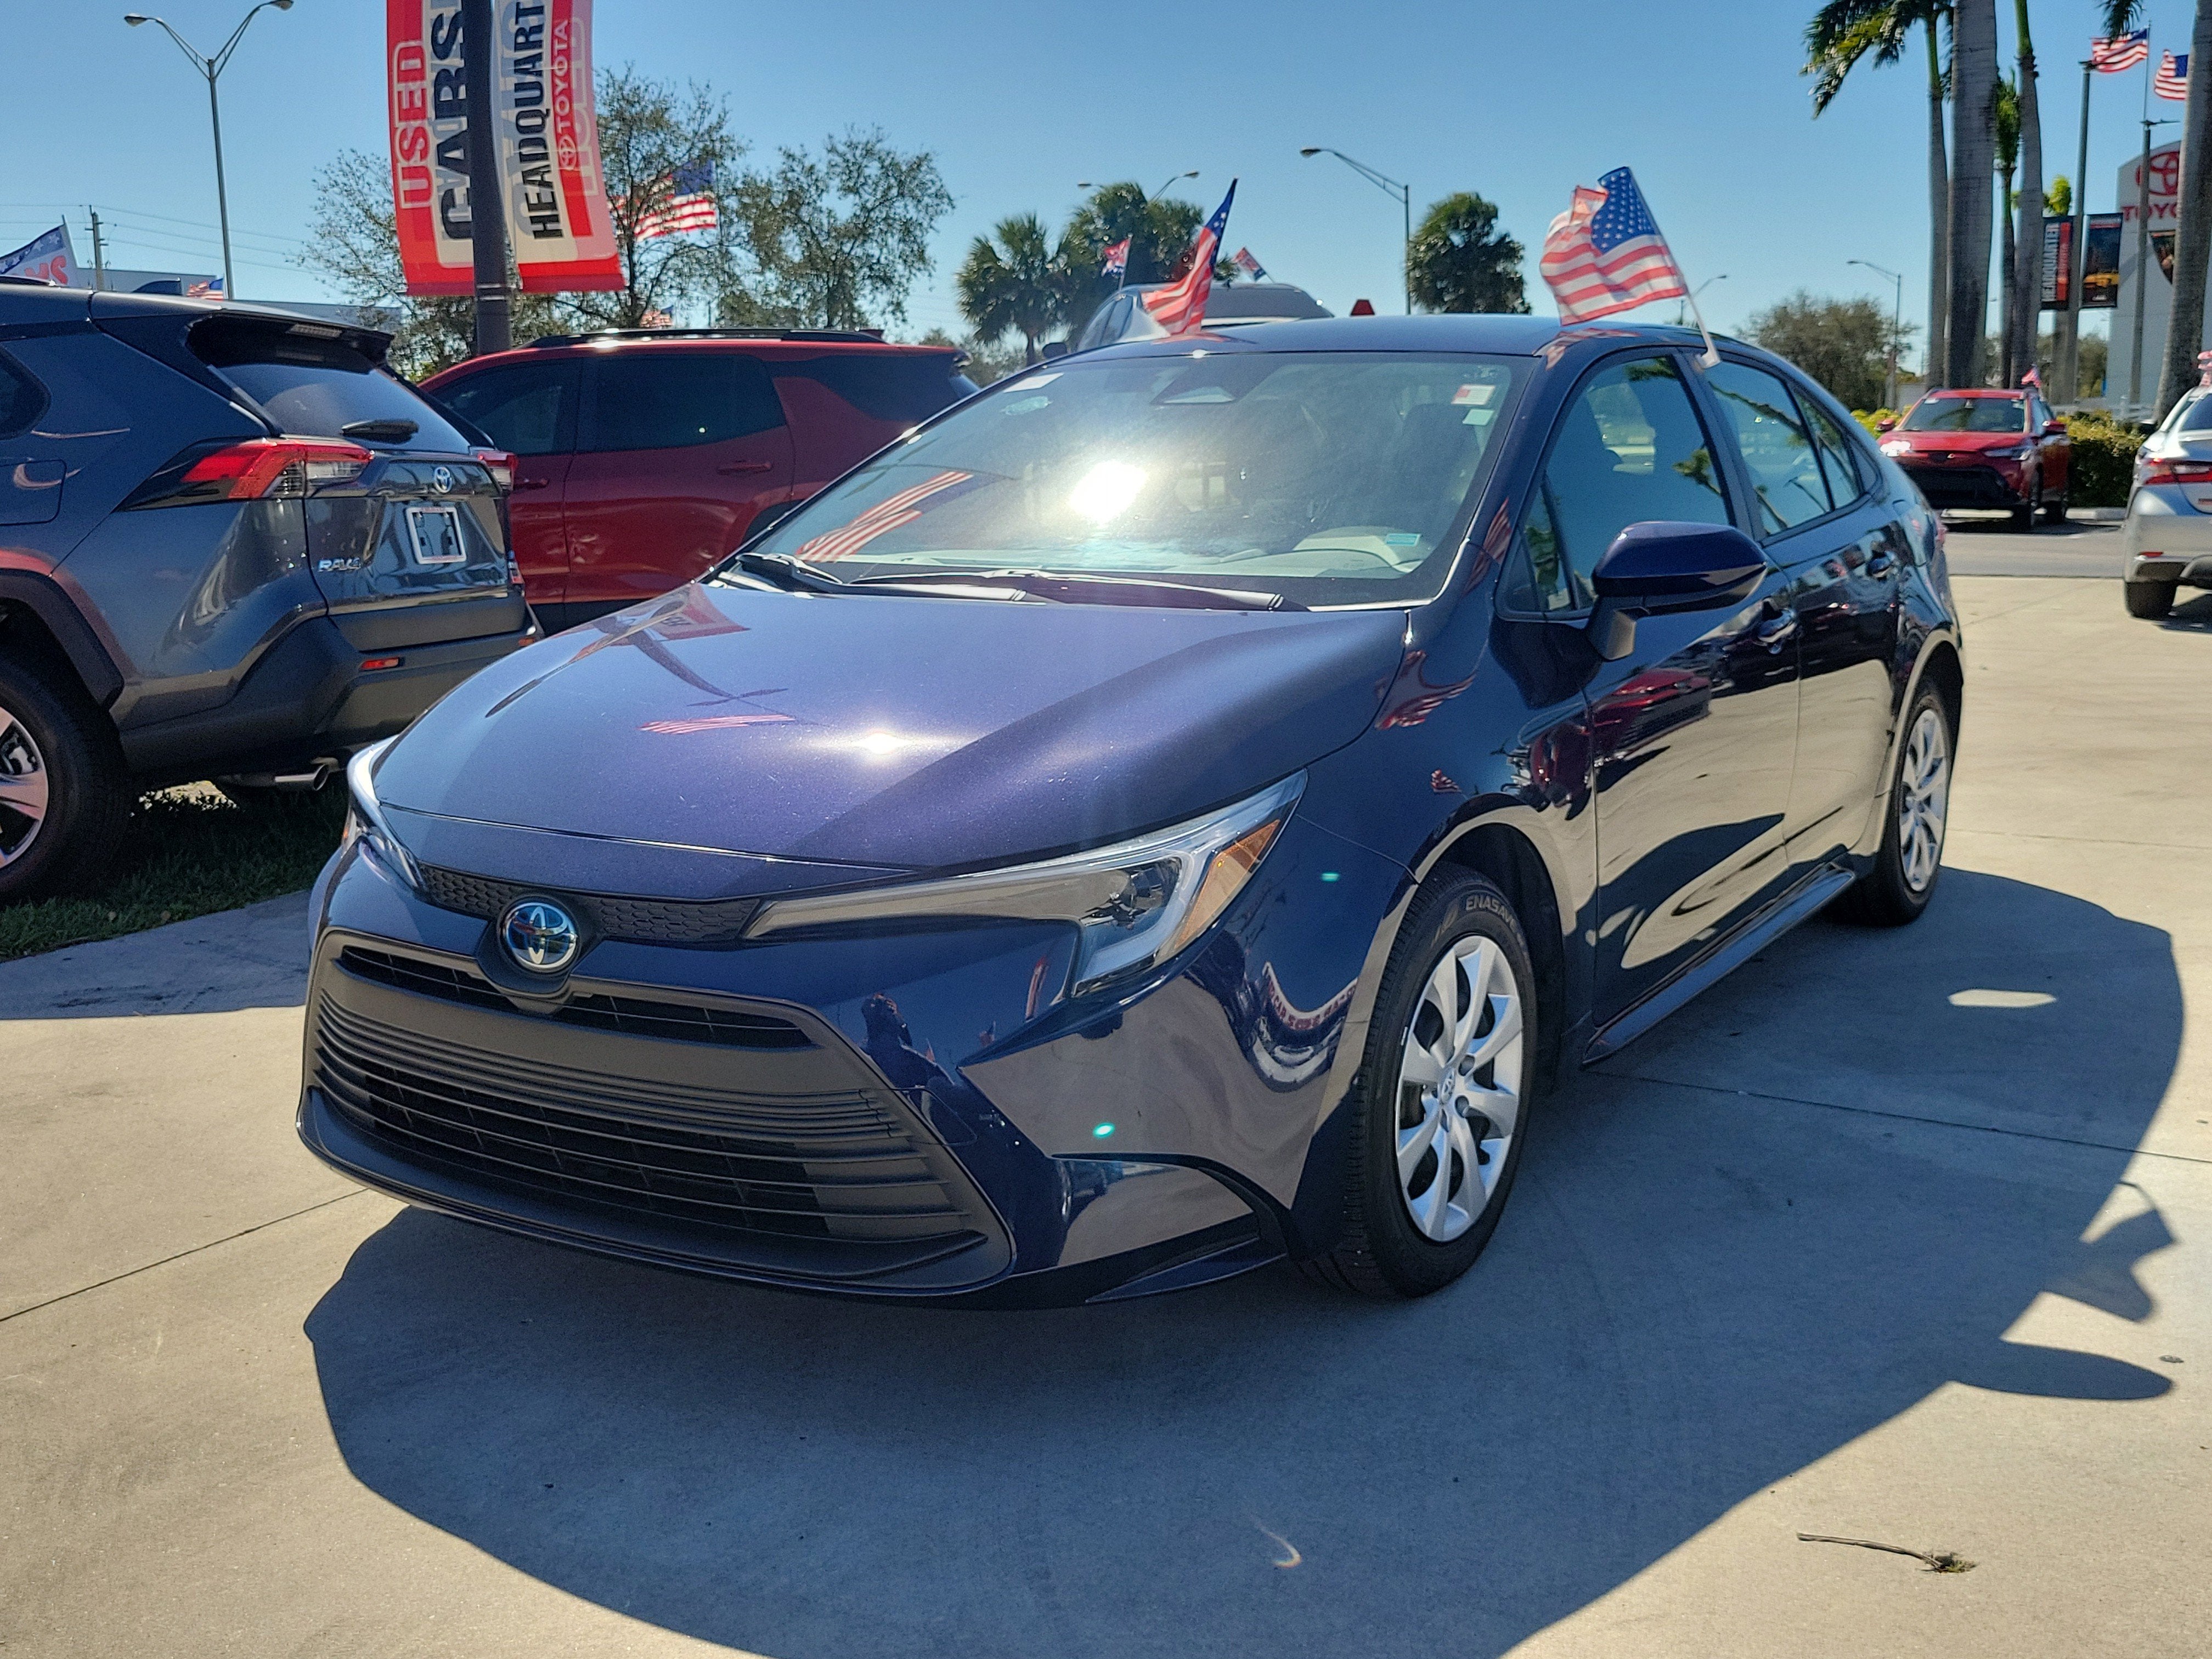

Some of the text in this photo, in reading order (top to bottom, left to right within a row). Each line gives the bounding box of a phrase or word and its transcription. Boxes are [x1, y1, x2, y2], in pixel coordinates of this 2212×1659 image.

[395, 42, 433, 208] USED
[431, 10, 473, 240] CARS
[514, 2, 564, 240] HEADQUART
[554, 19, 573, 134] TOYOTA
[318, 558, 360, 572] RAV4
